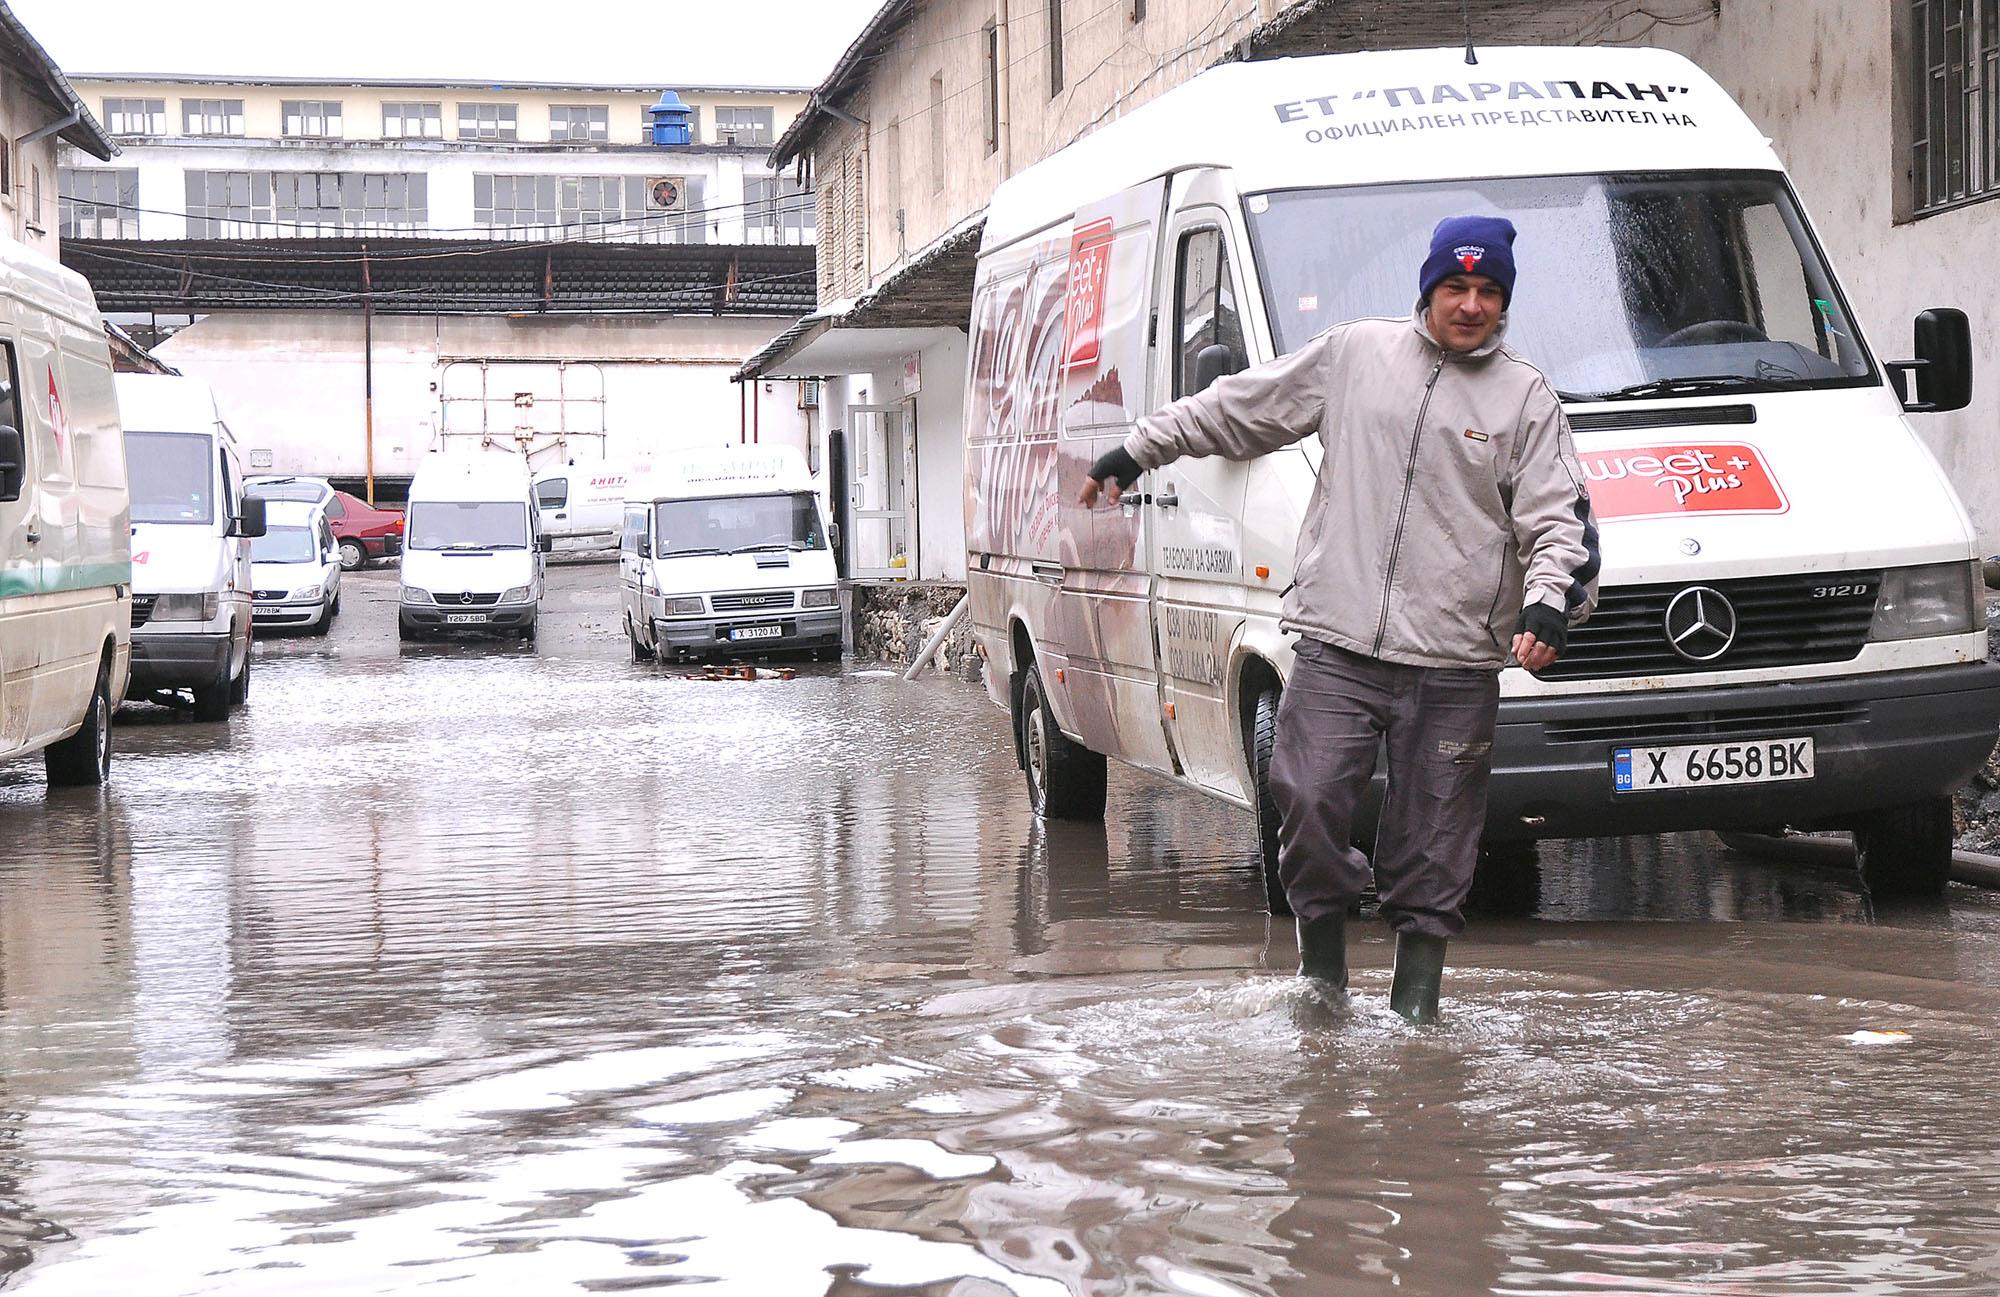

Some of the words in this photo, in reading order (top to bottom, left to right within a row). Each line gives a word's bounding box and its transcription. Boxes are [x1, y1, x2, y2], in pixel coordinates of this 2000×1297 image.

[1274, 95, 1338, 123] ЕТ
[1305, 112, 1466, 144] ОФИЦИАЛЕН
[1471, 109, 1658, 127] ПРЕДСТАВИТЕЛ
[1662, 112, 1697, 128] НА
[1654, 474, 1743, 504] Plus
[1205, 549, 1233, 574] ЗАЯВКИ
[748, 627, 768, 637] 3120
[1648, 752, 1668, 784] X
[1686, 747, 1763, 781] 6658
[1769, 742, 1808, 776] BK
[1617, 774, 1631, 784] BG
